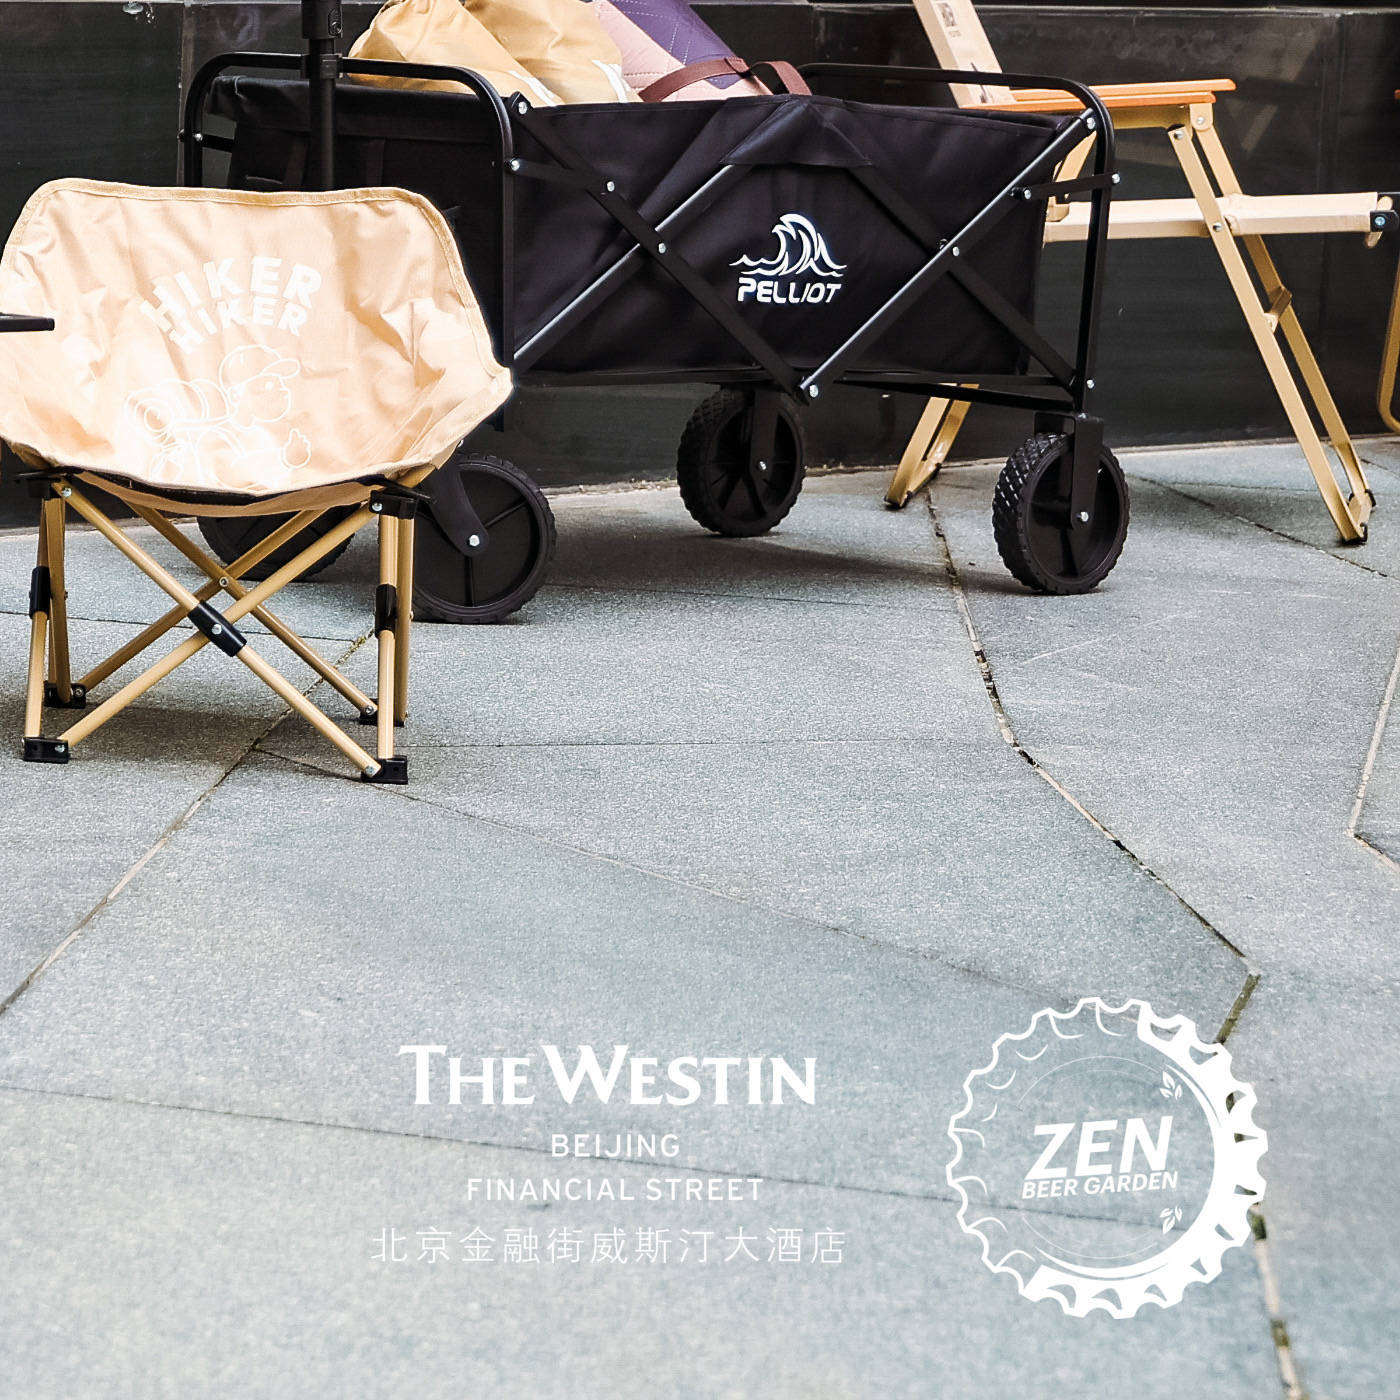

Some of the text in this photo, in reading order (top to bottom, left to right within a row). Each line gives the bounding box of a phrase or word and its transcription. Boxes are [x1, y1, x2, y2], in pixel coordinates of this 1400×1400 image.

[139, 255, 322, 333] HIKER
[737, 276, 842, 304] PELLIOT
[169, 295, 308, 355] HIKER
